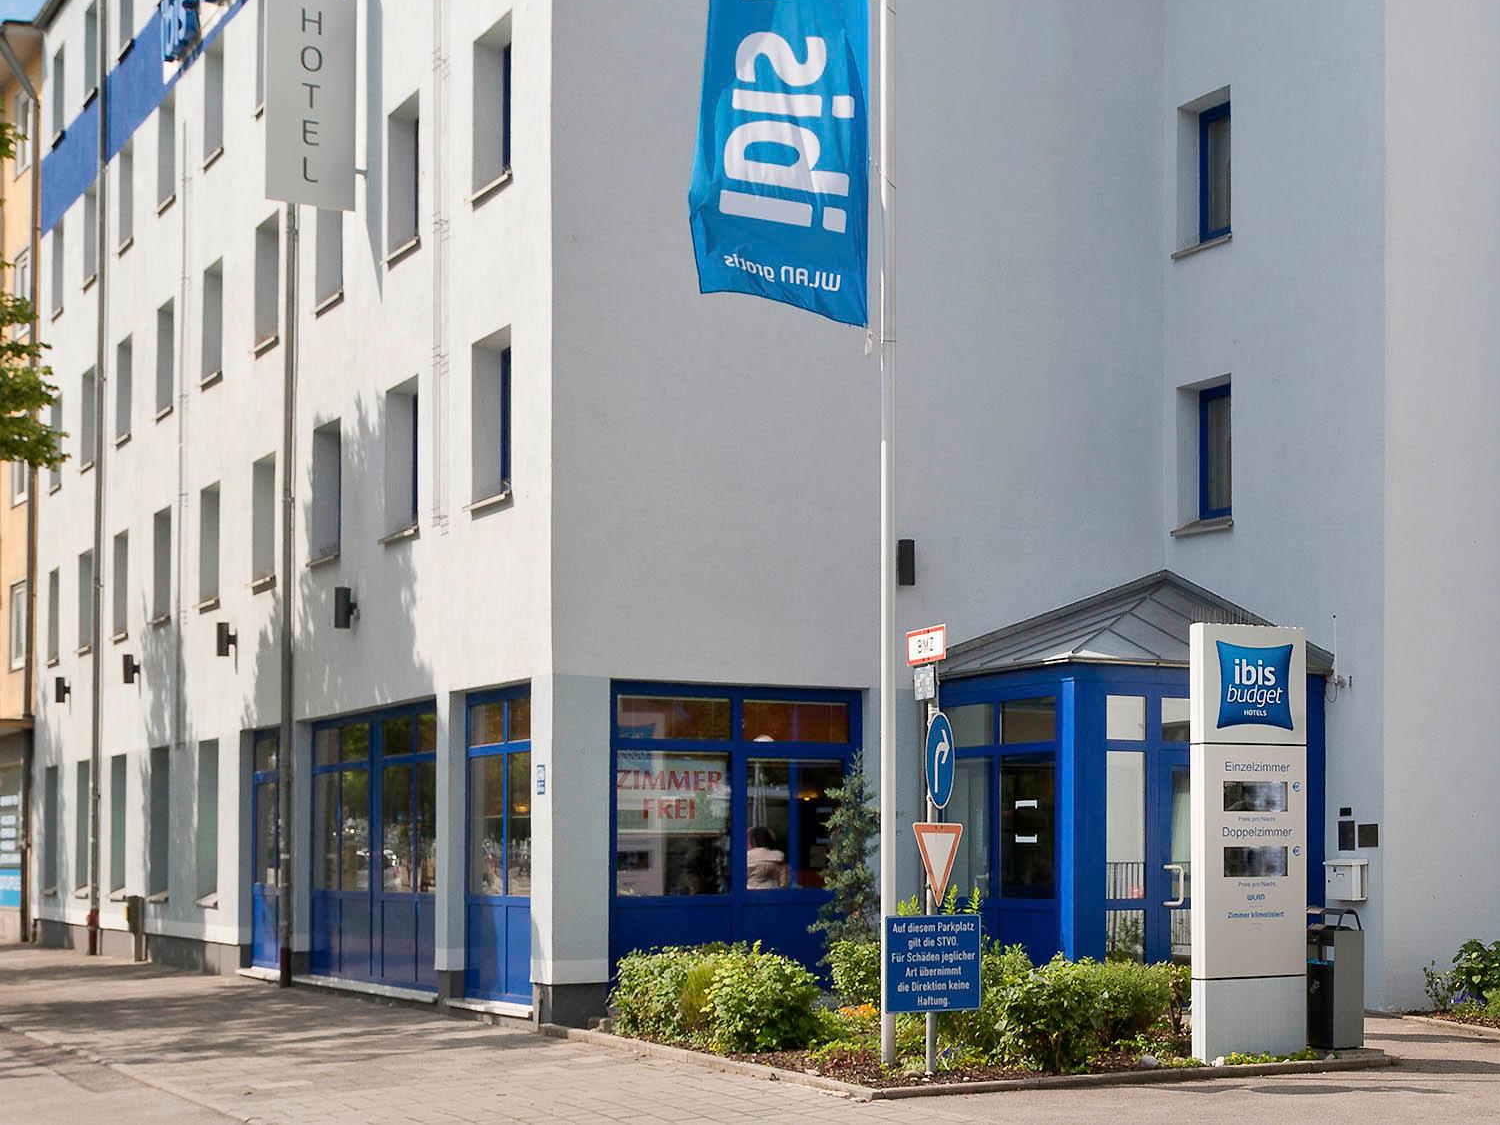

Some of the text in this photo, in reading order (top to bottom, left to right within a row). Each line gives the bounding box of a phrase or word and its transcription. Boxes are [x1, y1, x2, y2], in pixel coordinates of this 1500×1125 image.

[301, 8, 323, 183] HOTEL
[917, 636, 934, 654] BMZ
[1234, 658, 1276, 686] ibis
[1226, 683, 1284, 708] budget
[1243, 709, 1268, 717] HOTELS
[1224, 760, 1291, 773] Einzelzimmer
[616, 769, 723, 792] ZIMMER
[642, 795, 696, 820] FREI
[1222, 826, 1292, 840] Doppelzimmer
[1227, 911, 1250, 919] Zimmer
[892, 921, 975, 933] Auf diesem Parkplatz
[908, 937, 921, 950] gilt
[923, 937, 935, 947] die
[891, 950, 975, 963] Für Schäden jeglicher
[905, 965, 962, 977] Art übernimmt
[897, 979, 970, 993] die Direktion keine
